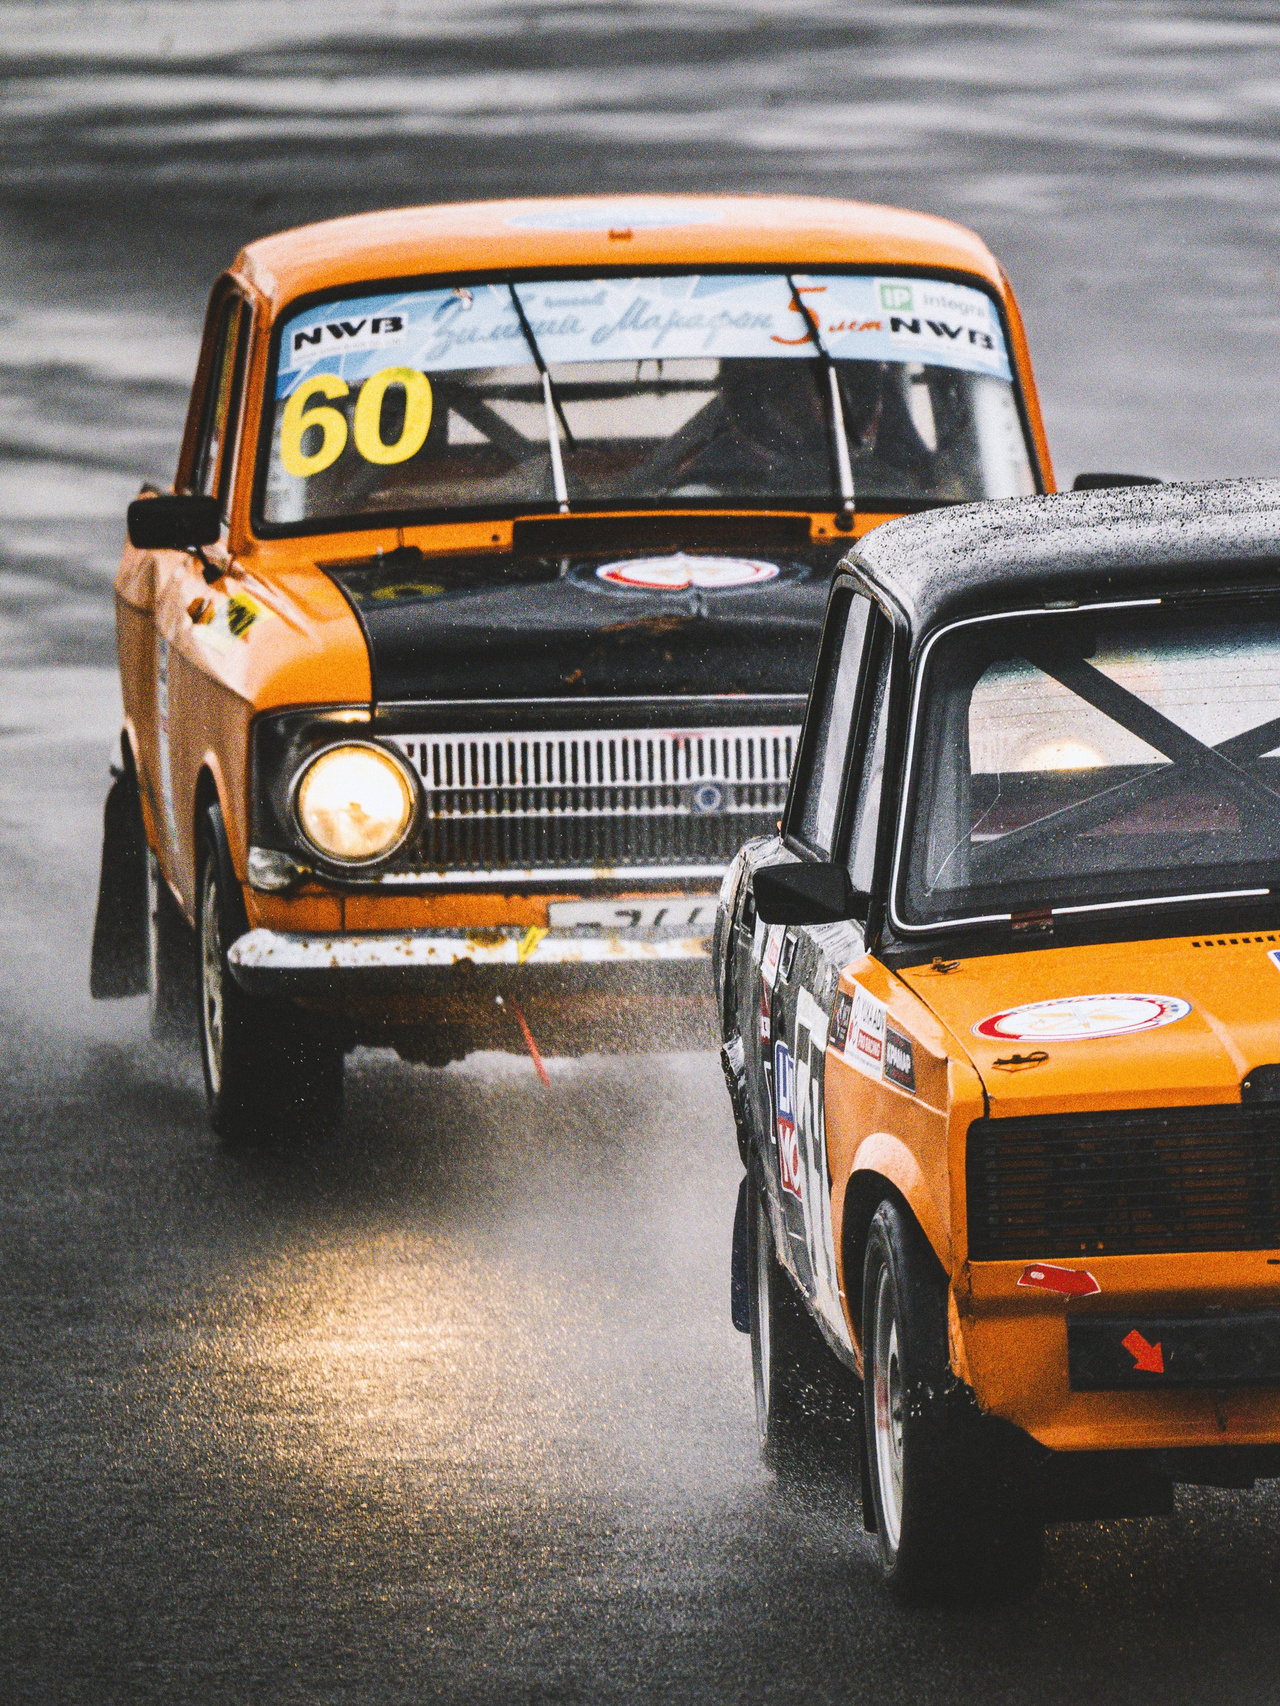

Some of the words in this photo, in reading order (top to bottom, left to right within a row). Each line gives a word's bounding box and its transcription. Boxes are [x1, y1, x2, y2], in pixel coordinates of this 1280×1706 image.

[294, 316, 404, 351] NWB
[770, 286, 827, 344] 5
[890, 316, 995, 350] NWB
[280, 366, 433, 478] 60
